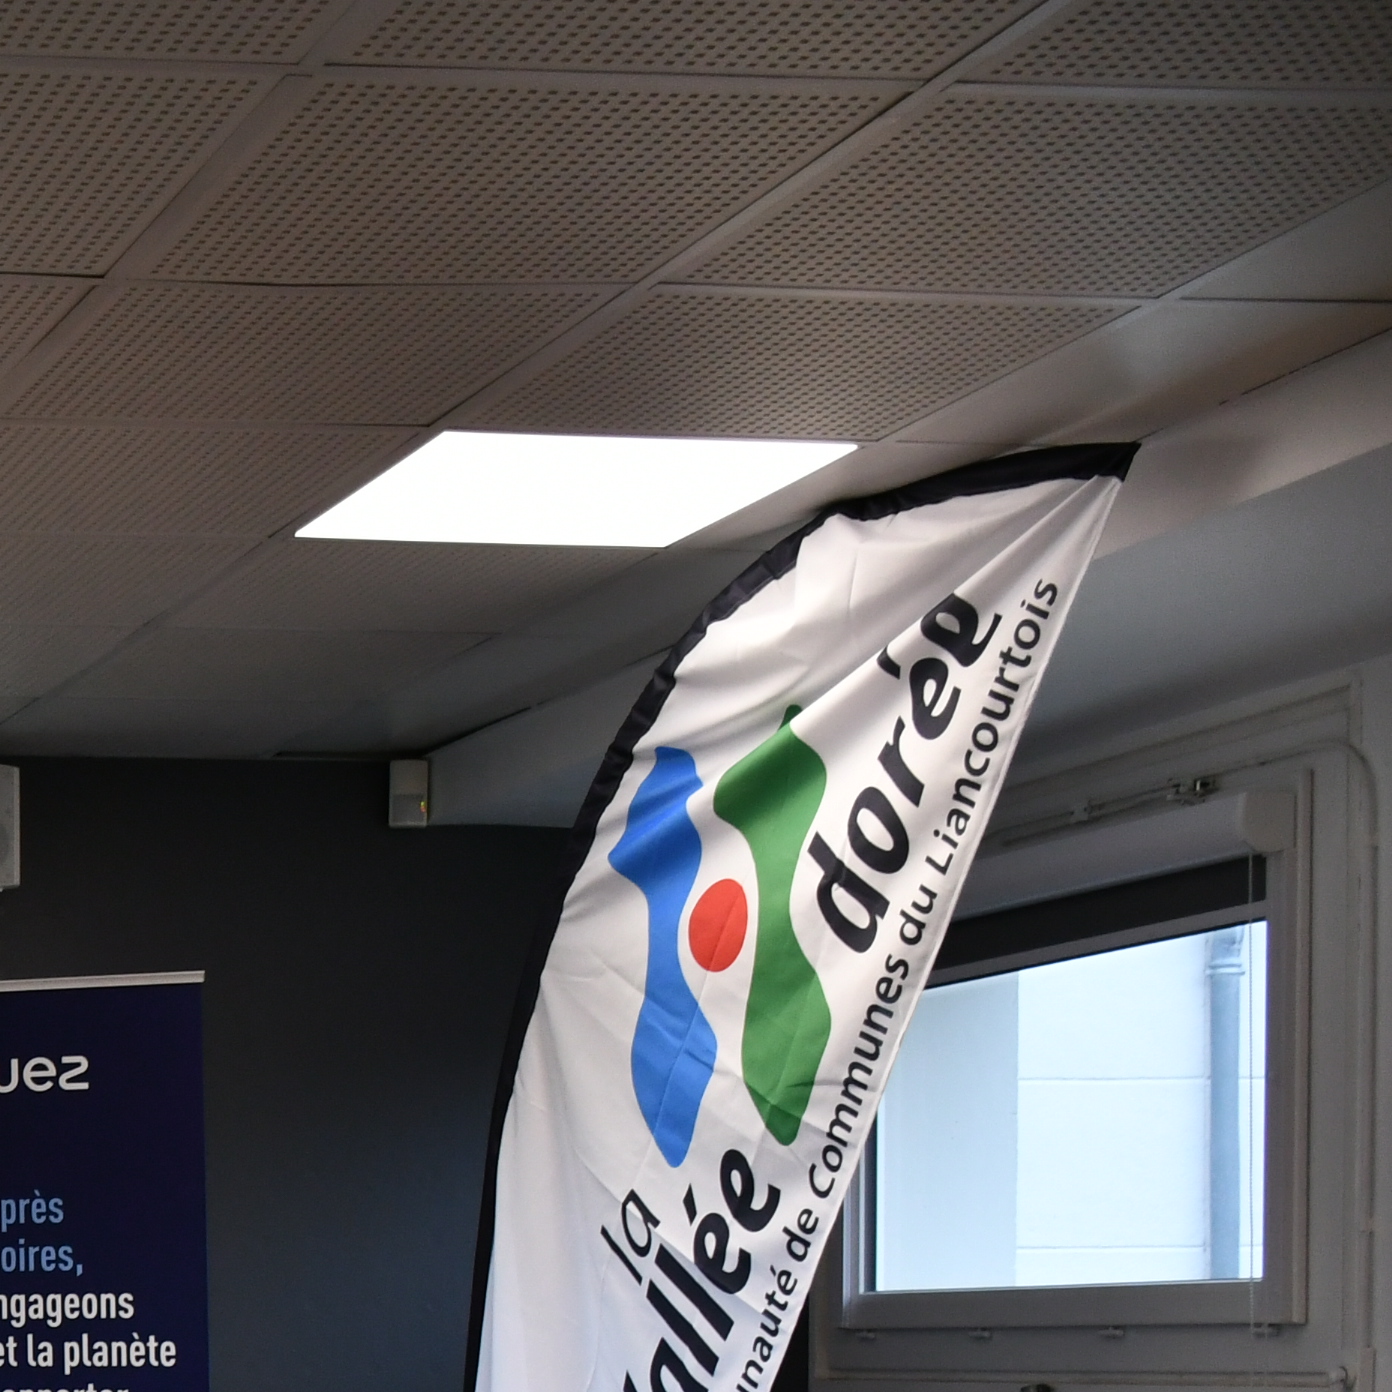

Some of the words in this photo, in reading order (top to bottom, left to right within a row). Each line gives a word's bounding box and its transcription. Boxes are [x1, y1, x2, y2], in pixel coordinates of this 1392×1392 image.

[807, 592, 1003, 953] dorée
[782, 1208, 820, 1262] de
[808, 953, 909, 1198] Communes
[899, 883, 939, 946] du
[924, 579, 1058, 876] Liancourtois
[0, 1189, 64, 1233] près
[600, 1189, 661, 1286] la
[27, 1333, 54, 1368] la
[63, 1332, 177, 1376] planète
